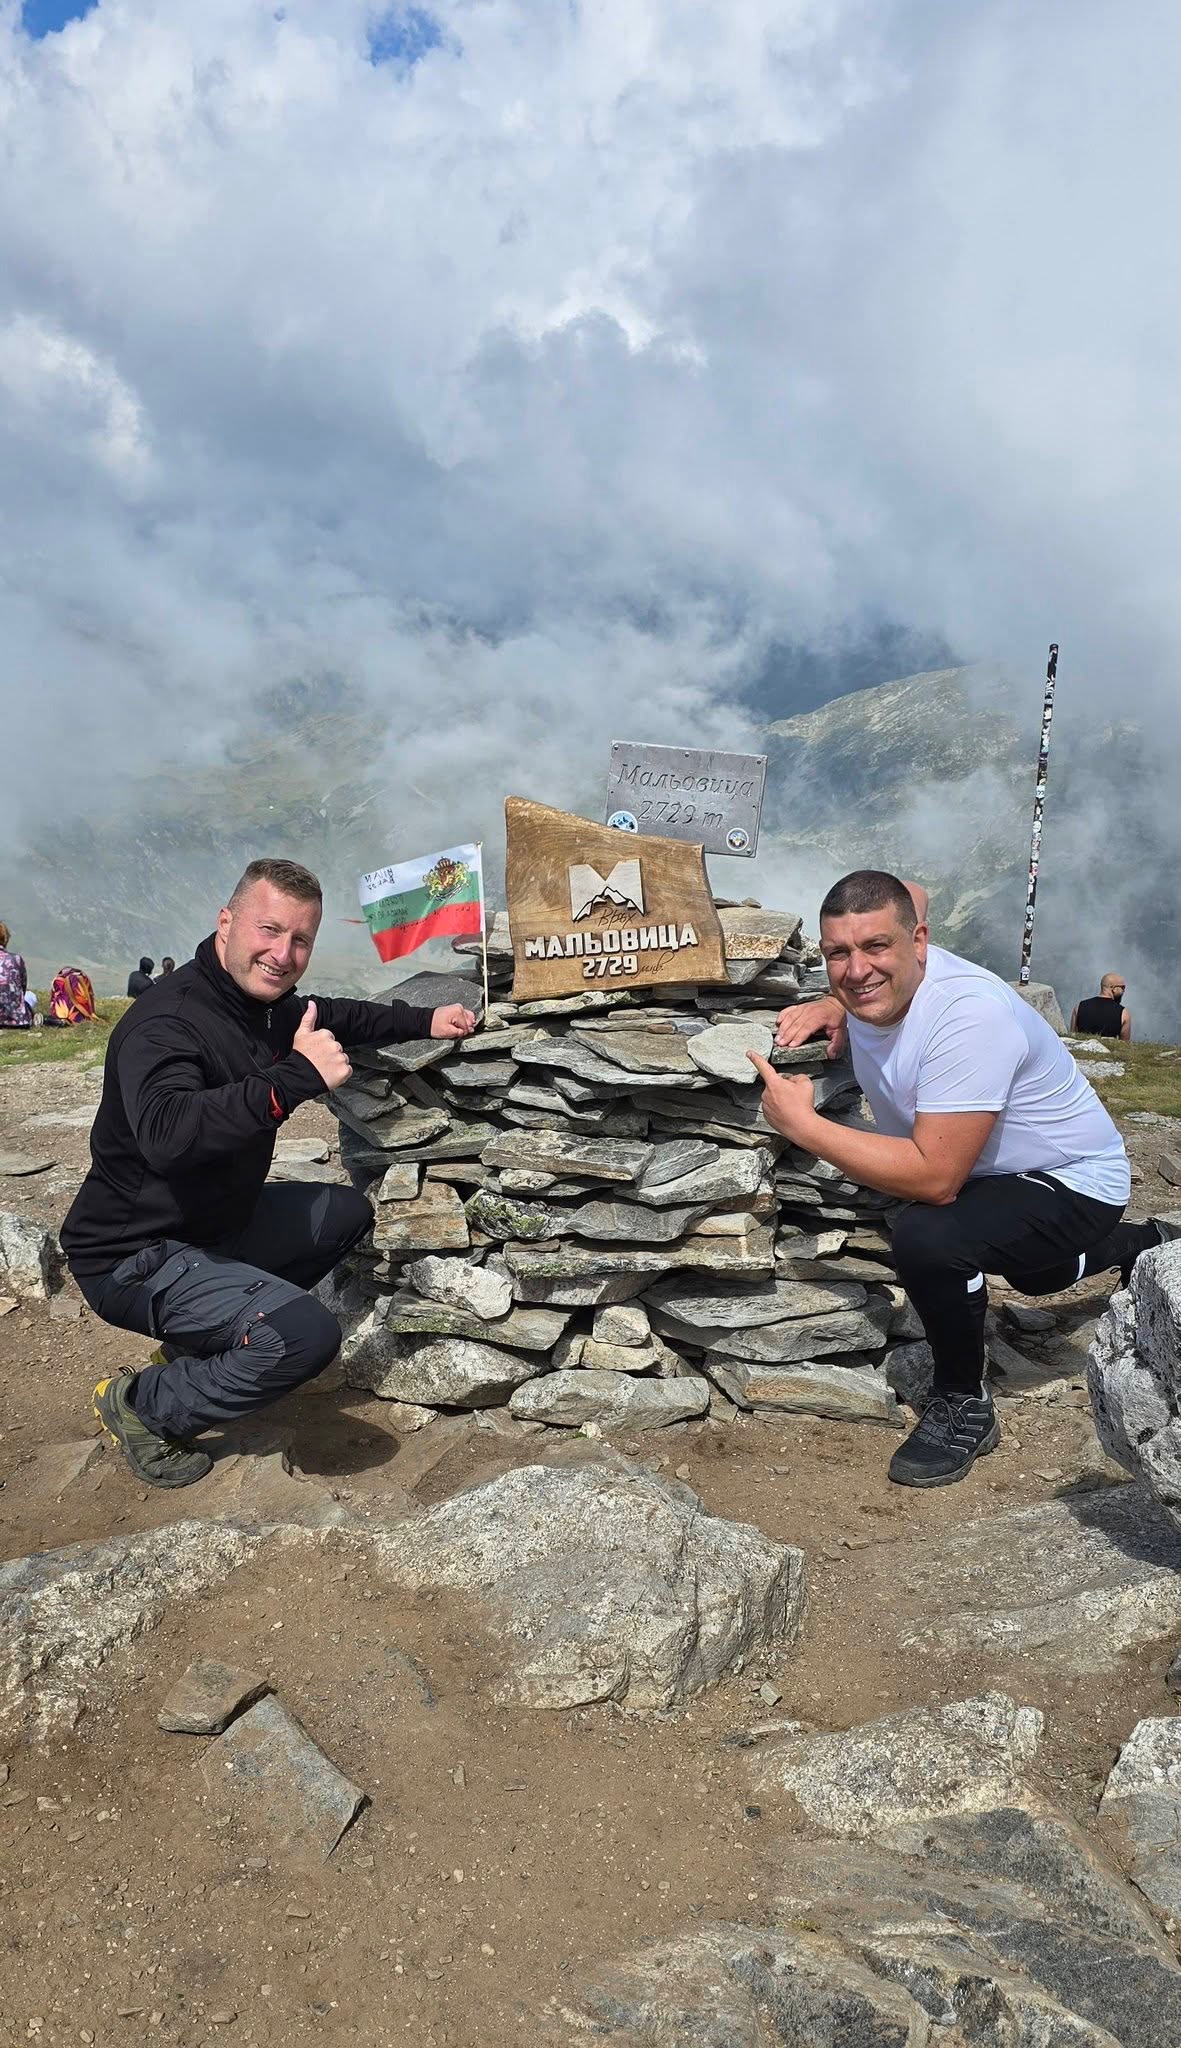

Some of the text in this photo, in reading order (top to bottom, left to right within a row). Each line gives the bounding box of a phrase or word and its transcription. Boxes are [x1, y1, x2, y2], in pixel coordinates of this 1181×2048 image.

[617, 763, 755, 800] Мальовица
[637, 800, 697, 825] 2729
[525, 922, 698, 959] МАЛЬОВИЦА
[582, 954, 639, 978] 2729
